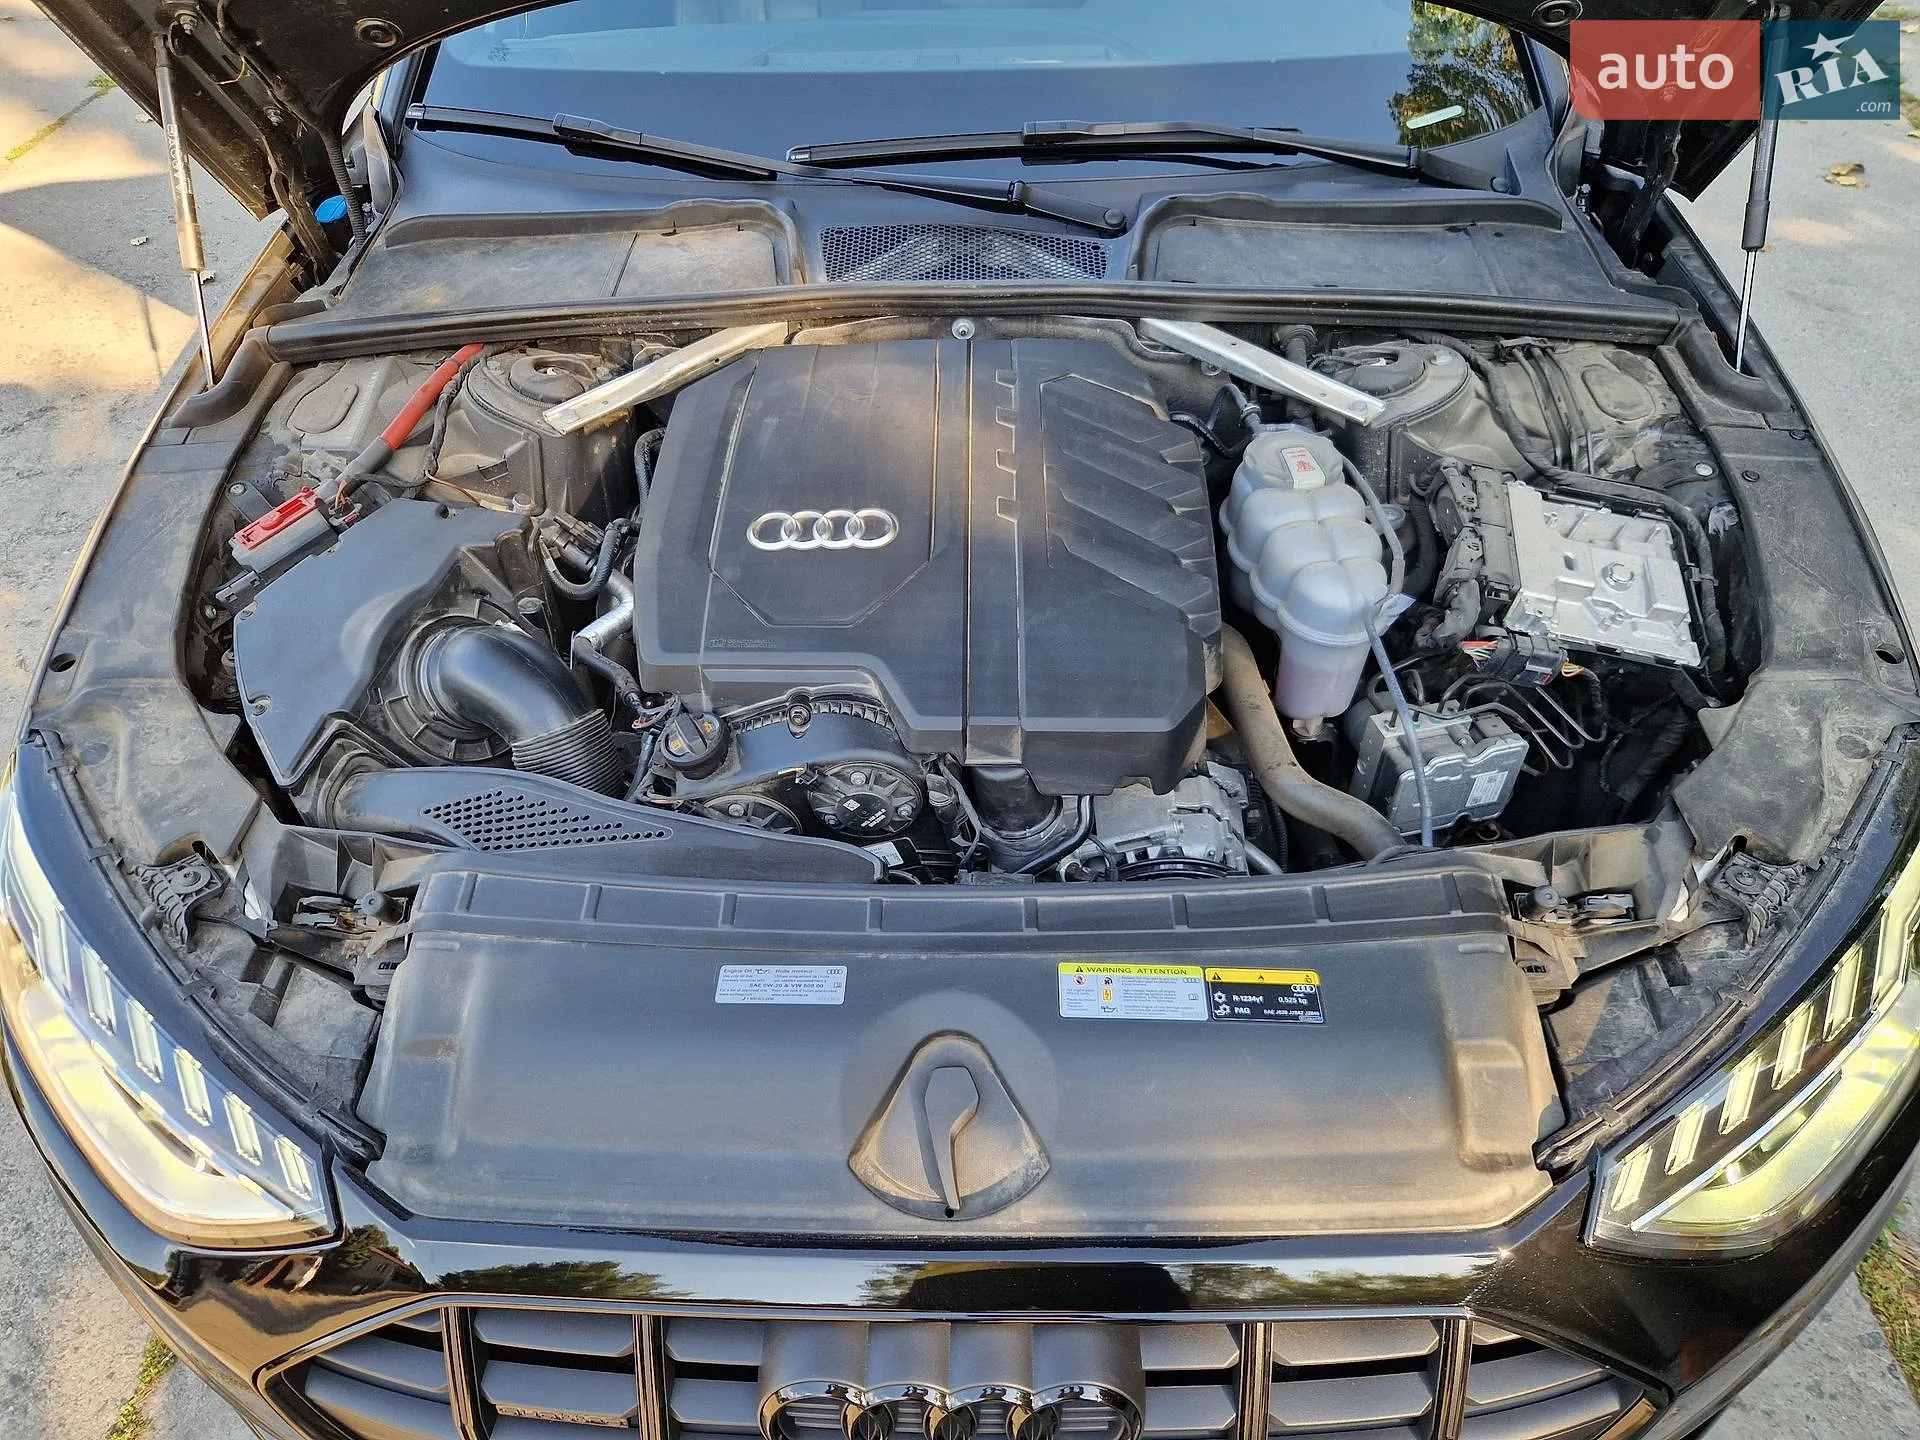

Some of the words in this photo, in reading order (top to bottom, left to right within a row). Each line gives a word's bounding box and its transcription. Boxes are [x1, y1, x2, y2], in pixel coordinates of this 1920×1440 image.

[1086, 966, 1132, 974] WARNING
[1232, 994, 1264, 1004] R-1234yf
[1234, 1006, 1251, 1014] PAG
